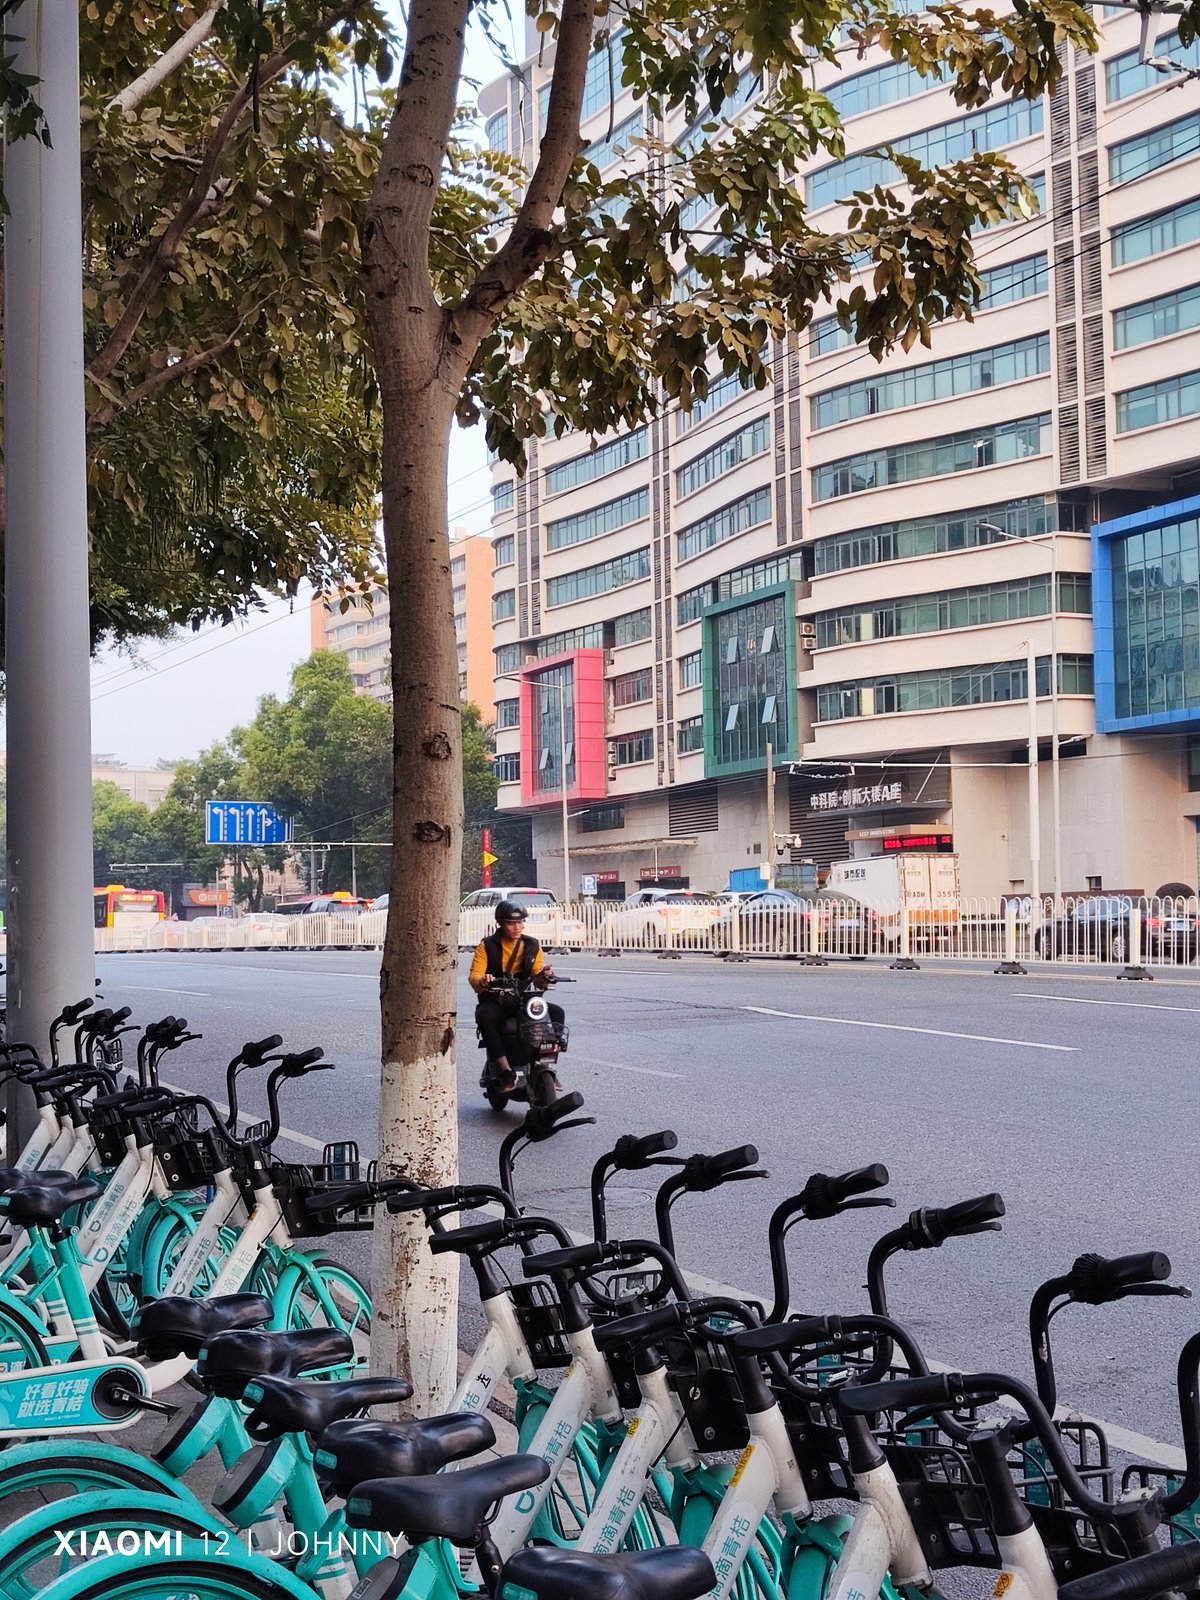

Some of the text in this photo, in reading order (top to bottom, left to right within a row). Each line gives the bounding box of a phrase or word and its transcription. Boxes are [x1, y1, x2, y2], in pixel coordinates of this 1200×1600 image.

[24, 1377, 91, 1401] 好看好骑
[16, 1396, 86, 1419] 就选青桔
